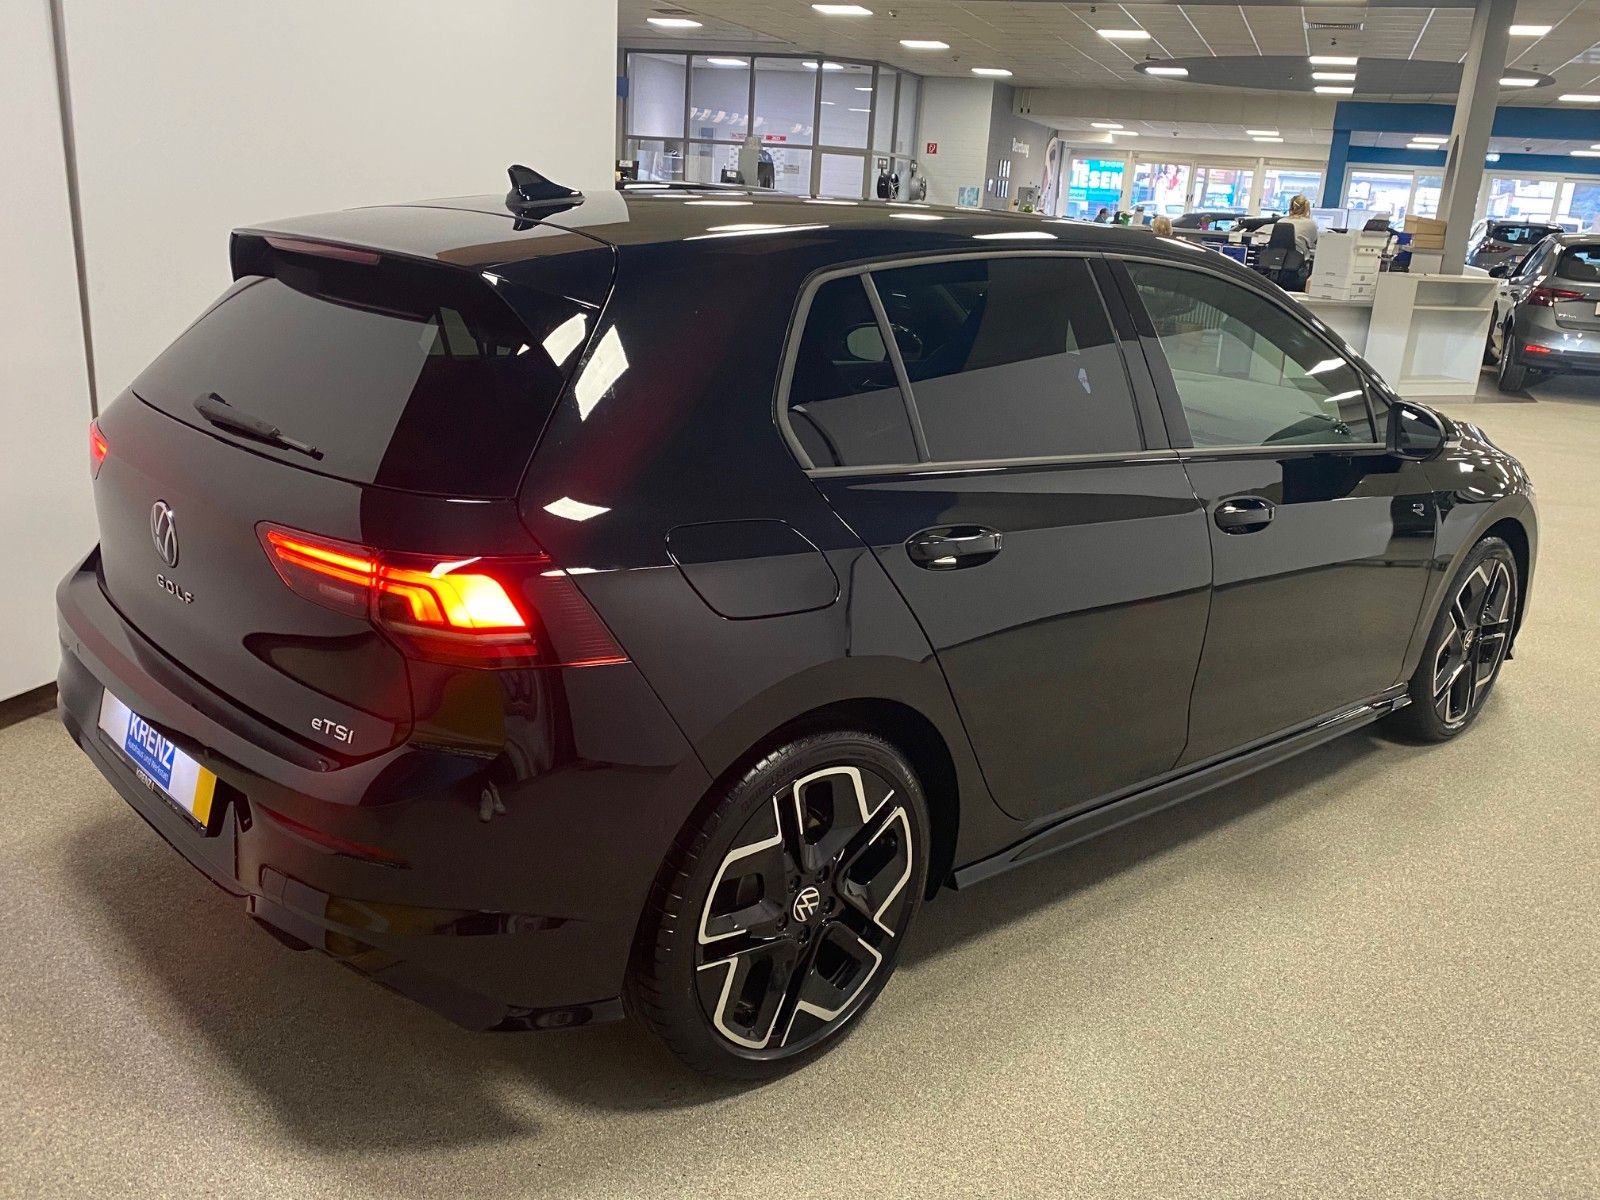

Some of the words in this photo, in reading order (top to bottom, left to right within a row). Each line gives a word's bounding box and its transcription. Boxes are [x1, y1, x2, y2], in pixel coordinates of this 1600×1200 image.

[157, 574, 194, 604] GOLF
[129, 712, 174, 770] KRENZ
[311, 717, 354, 744] eTSI
